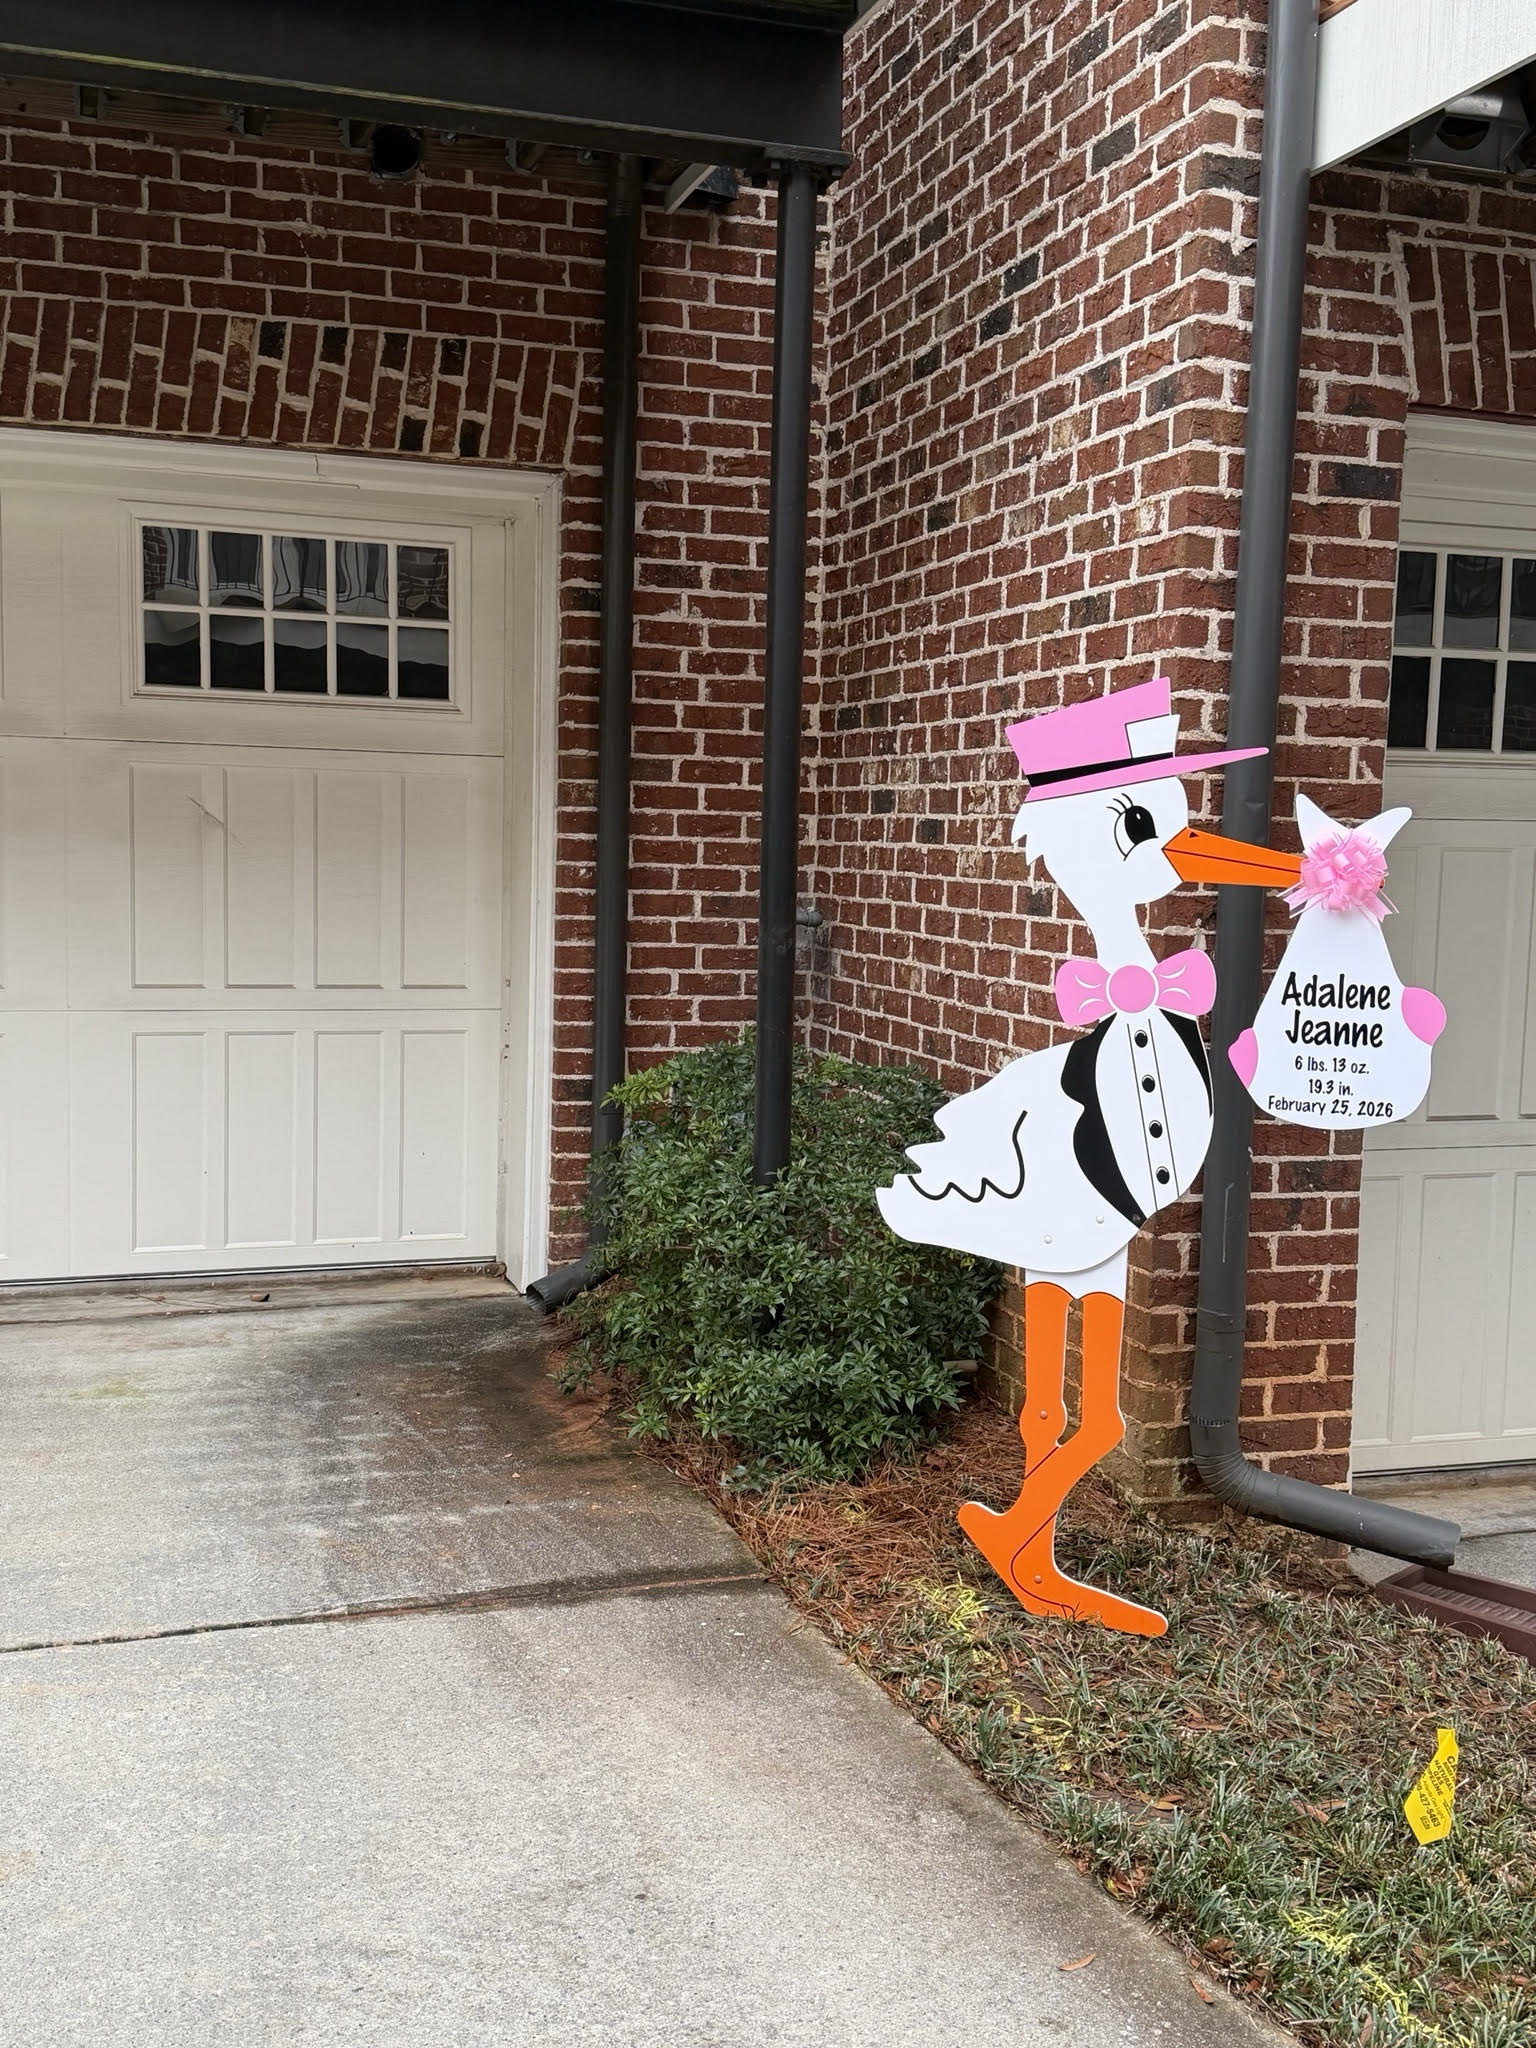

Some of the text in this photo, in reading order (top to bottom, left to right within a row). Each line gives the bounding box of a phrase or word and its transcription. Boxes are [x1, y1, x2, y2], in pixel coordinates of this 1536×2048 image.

[1281, 971, 1391, 1011] Adalene
[1285, 1009, 1383, 1048] Jeanne
[1294, 1055, 1370, 1075] 6 lbs. 13 oz.
[1308, 1078, 1354, 1096] 19.3 in.
[1268, 1095, 1394, 1118] February 25, 2026
[1433, 1770, 1445, 1785] GAS
[1434, 1759, 1454, 1792] NATURAL
